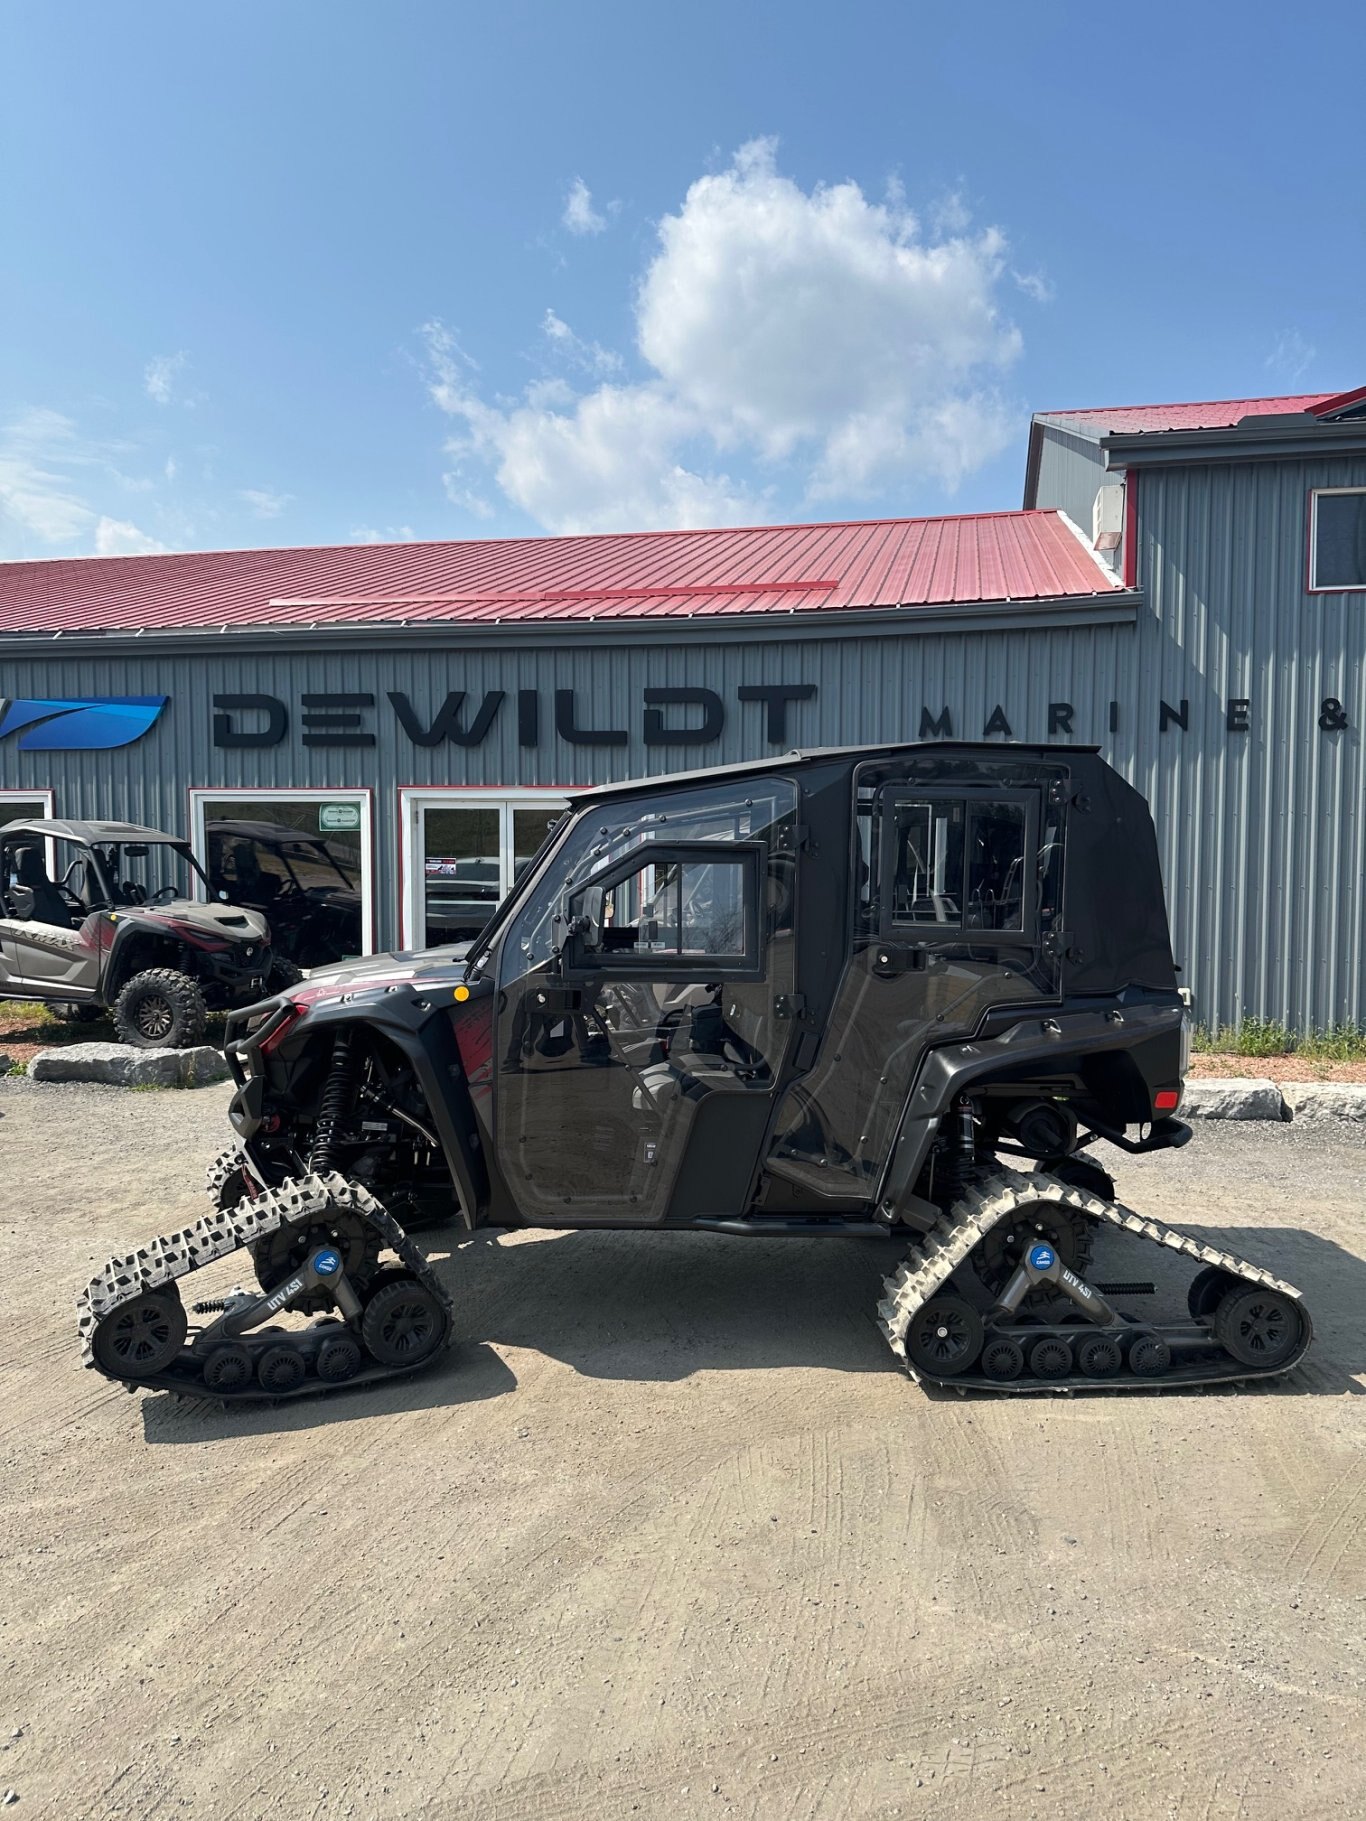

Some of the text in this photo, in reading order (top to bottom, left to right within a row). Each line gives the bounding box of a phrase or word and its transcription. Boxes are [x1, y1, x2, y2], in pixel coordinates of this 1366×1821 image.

[213, 685, 1348, 747] DEWILDT MARINE &
[1063, 1269, 1079, 1287] UTV
[267, 1292, 286, 1311] UTV
